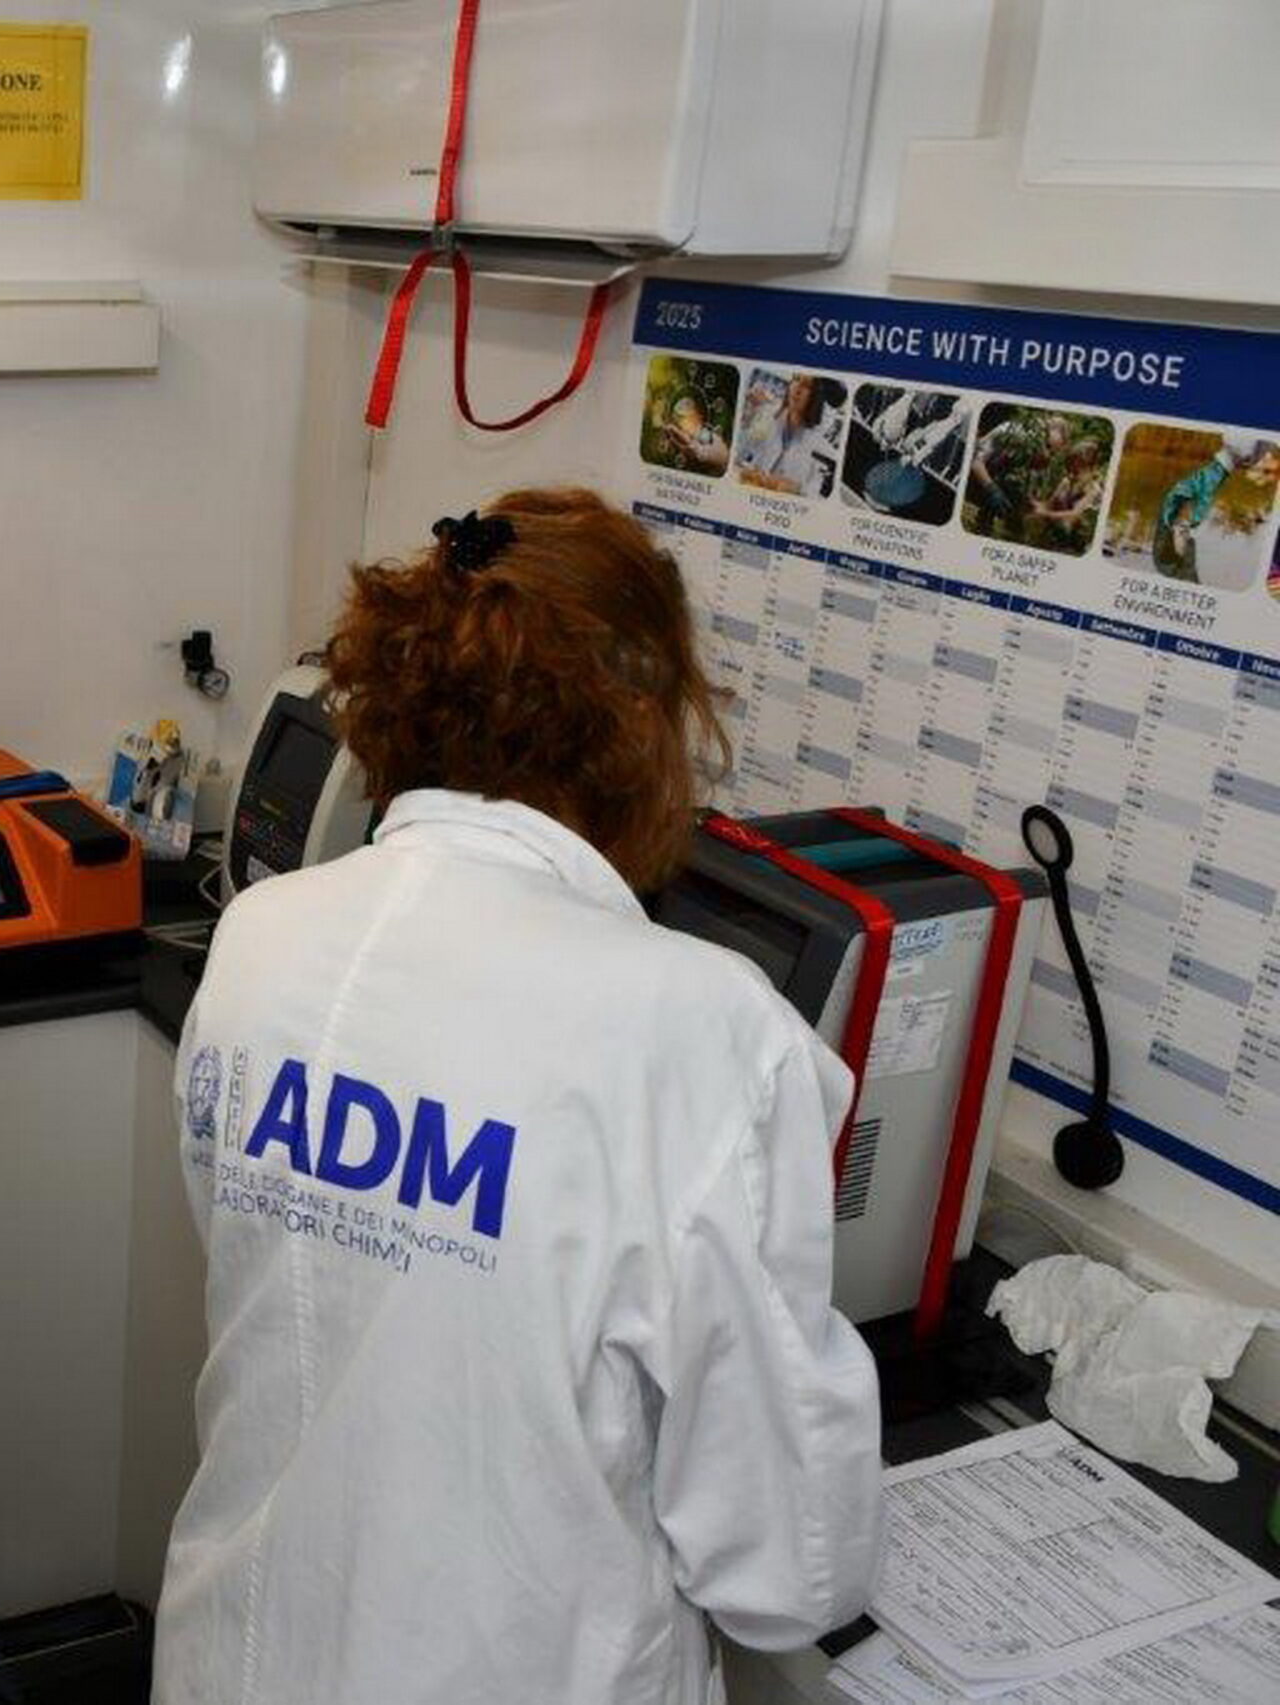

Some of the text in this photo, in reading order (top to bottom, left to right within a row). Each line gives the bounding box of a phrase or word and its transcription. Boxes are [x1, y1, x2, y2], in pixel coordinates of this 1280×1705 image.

[655, 302, 702, 329] 2025
[804, 316, 1185, 389] SCIENCE WITH PURPOSE
[1119, 576, 1218, 612] FOR A BETTER
[244, 1057, 517, 1240] ADM
